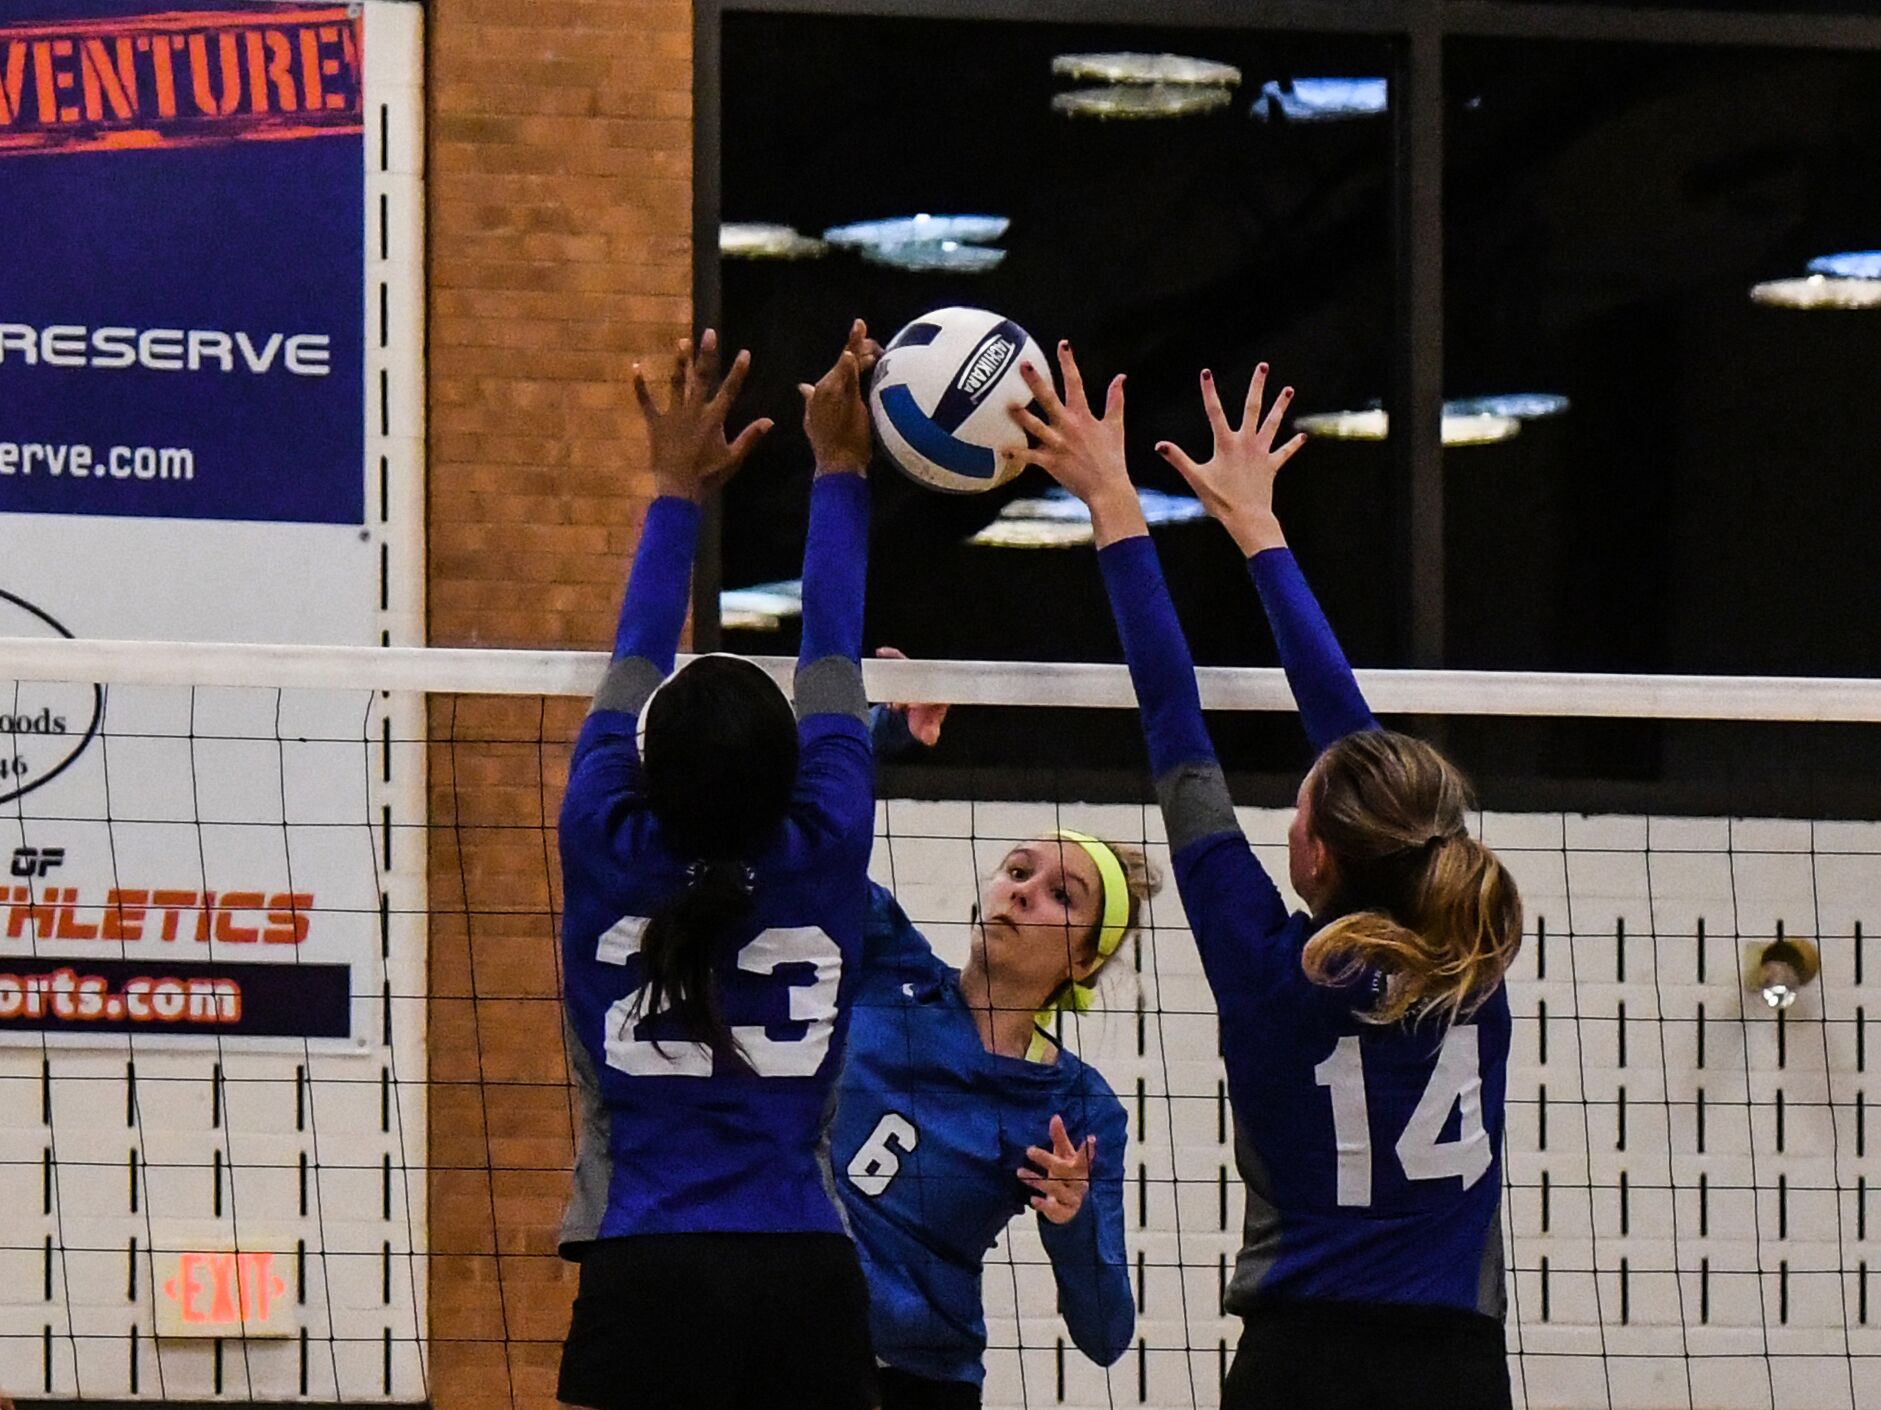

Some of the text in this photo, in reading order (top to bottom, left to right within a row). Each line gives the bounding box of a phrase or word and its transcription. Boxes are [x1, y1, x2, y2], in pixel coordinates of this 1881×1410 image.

[0, 323, 330, 374] RESERVE
[963, 338, 1014, 393] TACHIKARA
[0, 442, 195, 480] erve.com
[0, 707, 66, 734] oods
[10, 848, 65, 877] OF
[0, 885, 314, 944] HLETICS
[596, 915, 843, 1078] 23
[1314, 1023, 1493, 1208] 14
[847, 1112, 919, 1197] 6
[180, 1252, 274, 1324] EXIT
